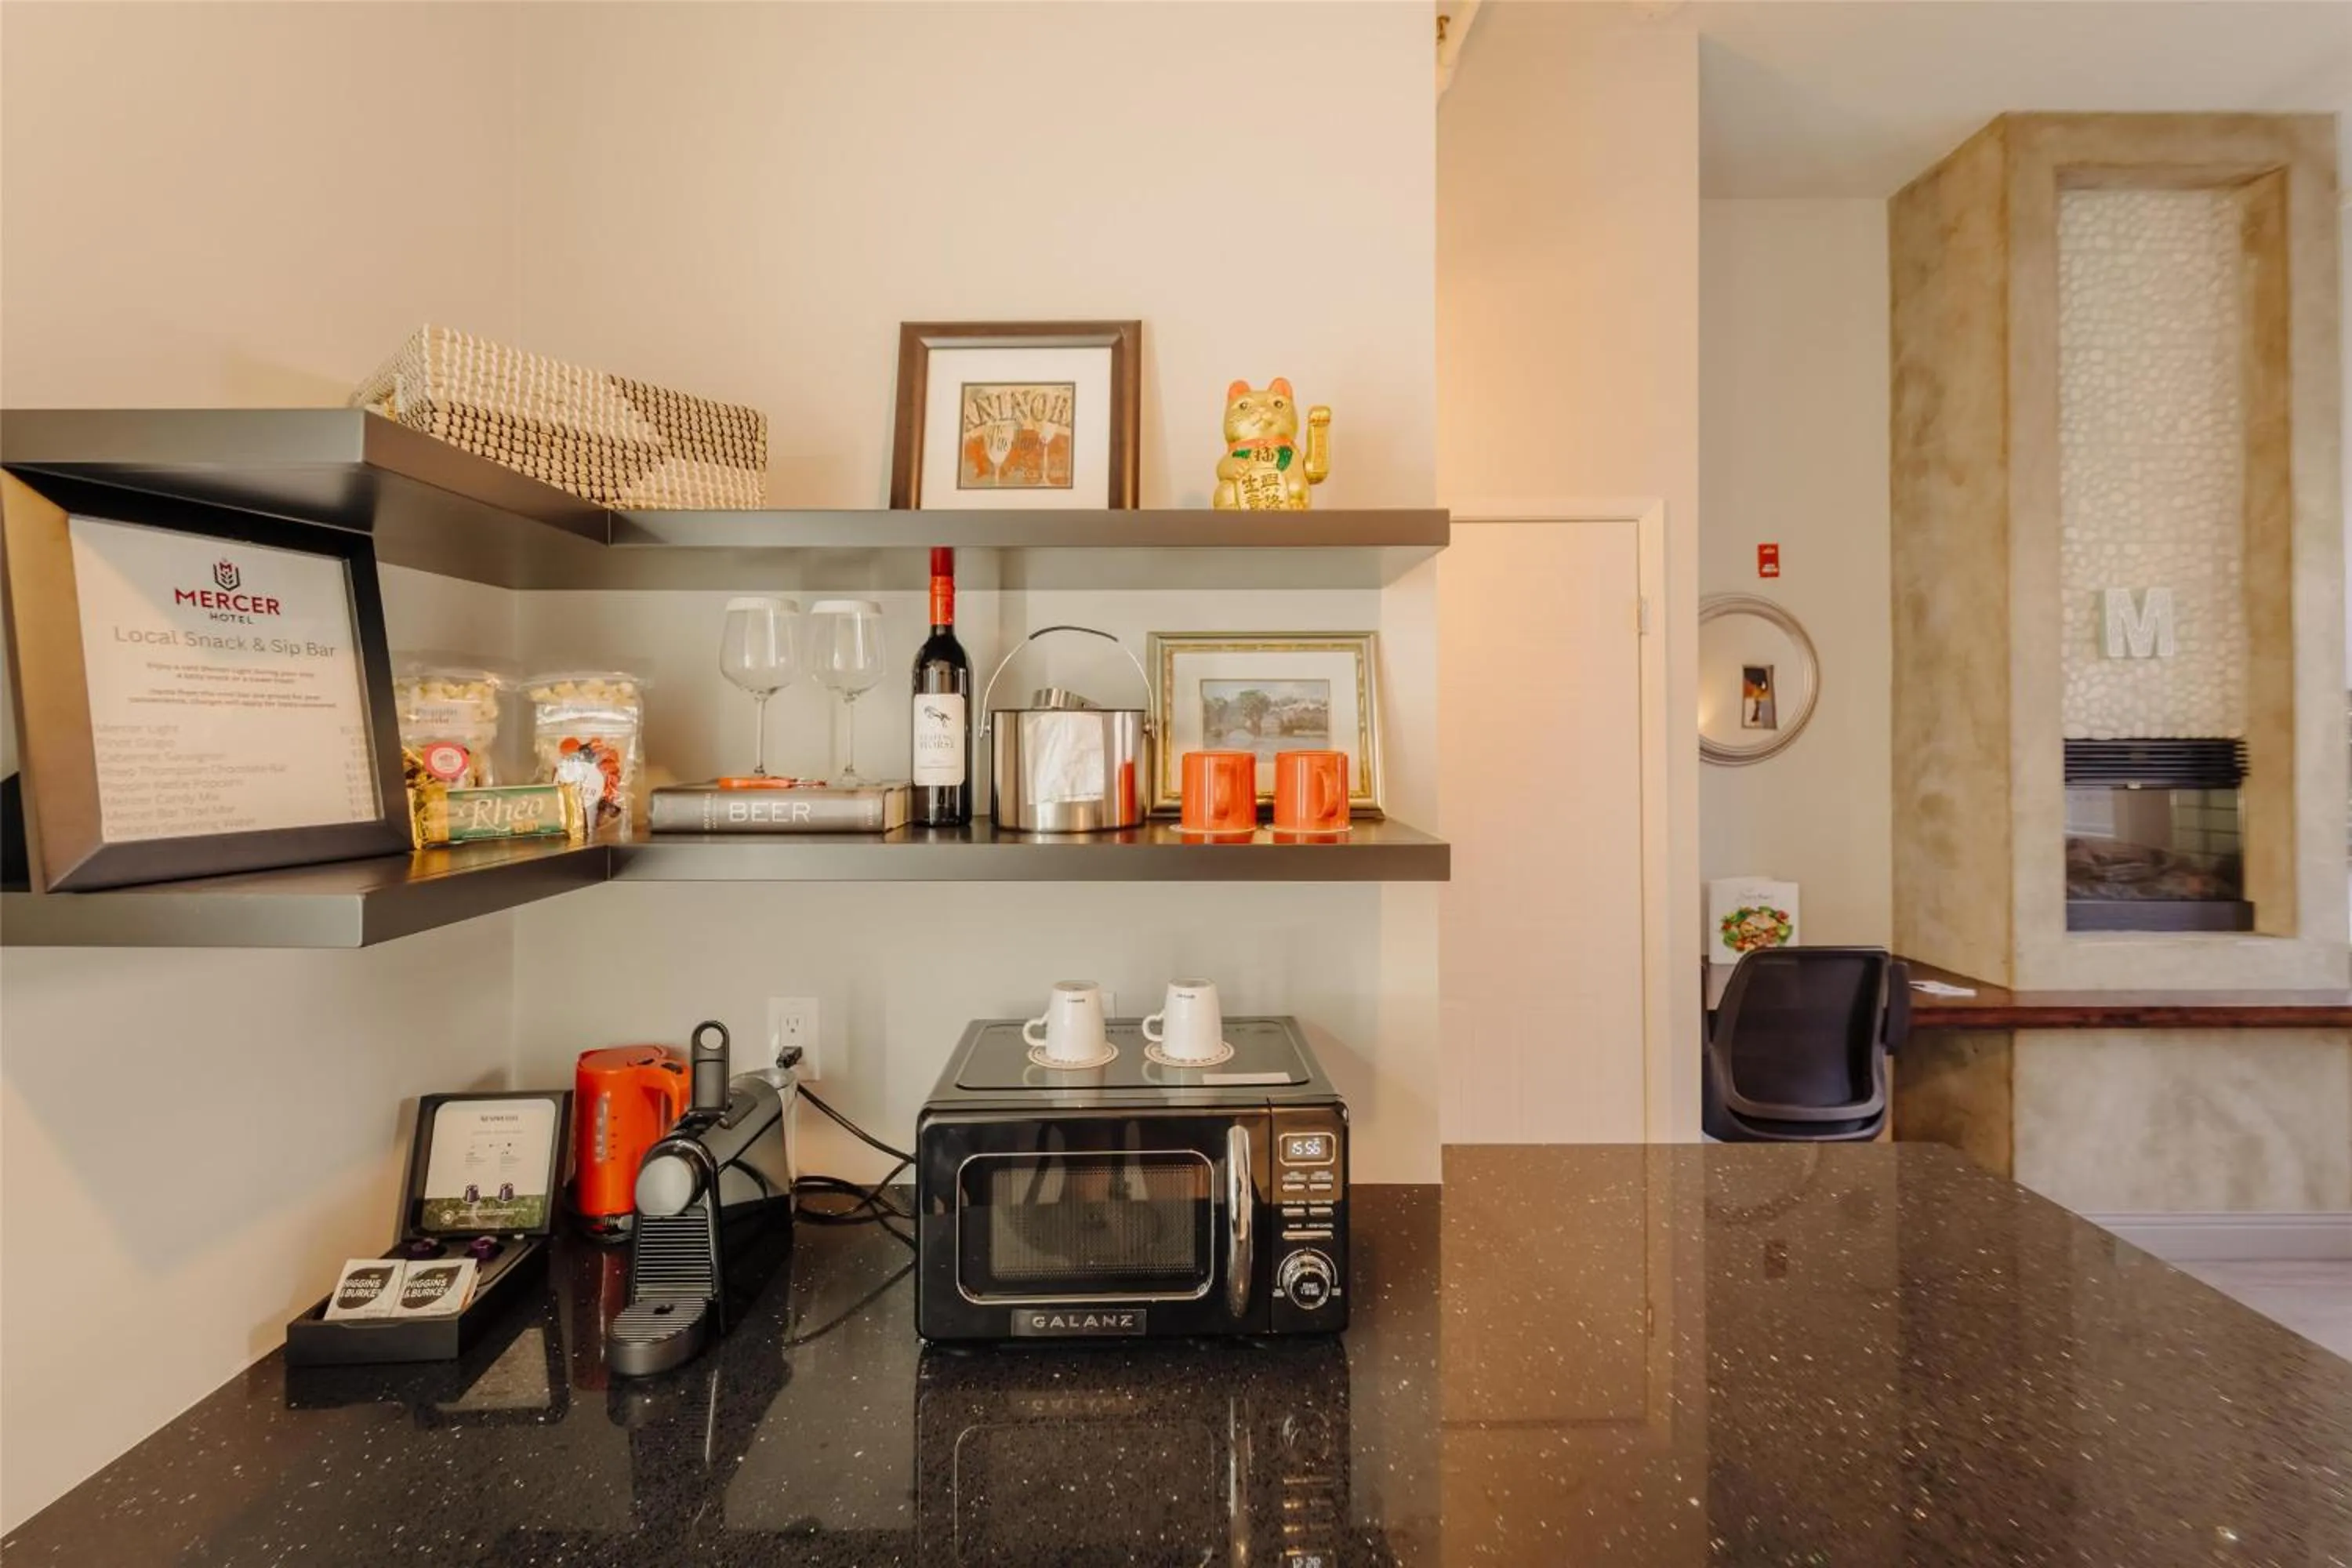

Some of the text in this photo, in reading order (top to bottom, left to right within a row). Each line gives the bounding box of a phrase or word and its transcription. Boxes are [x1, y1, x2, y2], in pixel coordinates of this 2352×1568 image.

[174, 588, 281, 615] MERCER
[209, 613, 254, 625] HOTEL
[2105, 587, 2174, 657] M
[114, 626, 336, 657] Local Snack & Sip Bar
[728, 801, 812, 822] BEER
[344, 1279, 383, 1288] HIGGINS
[407, 1278, 448, 1288] HIGGINS
[1032, 1314, 1134, 1328] GALANZ
